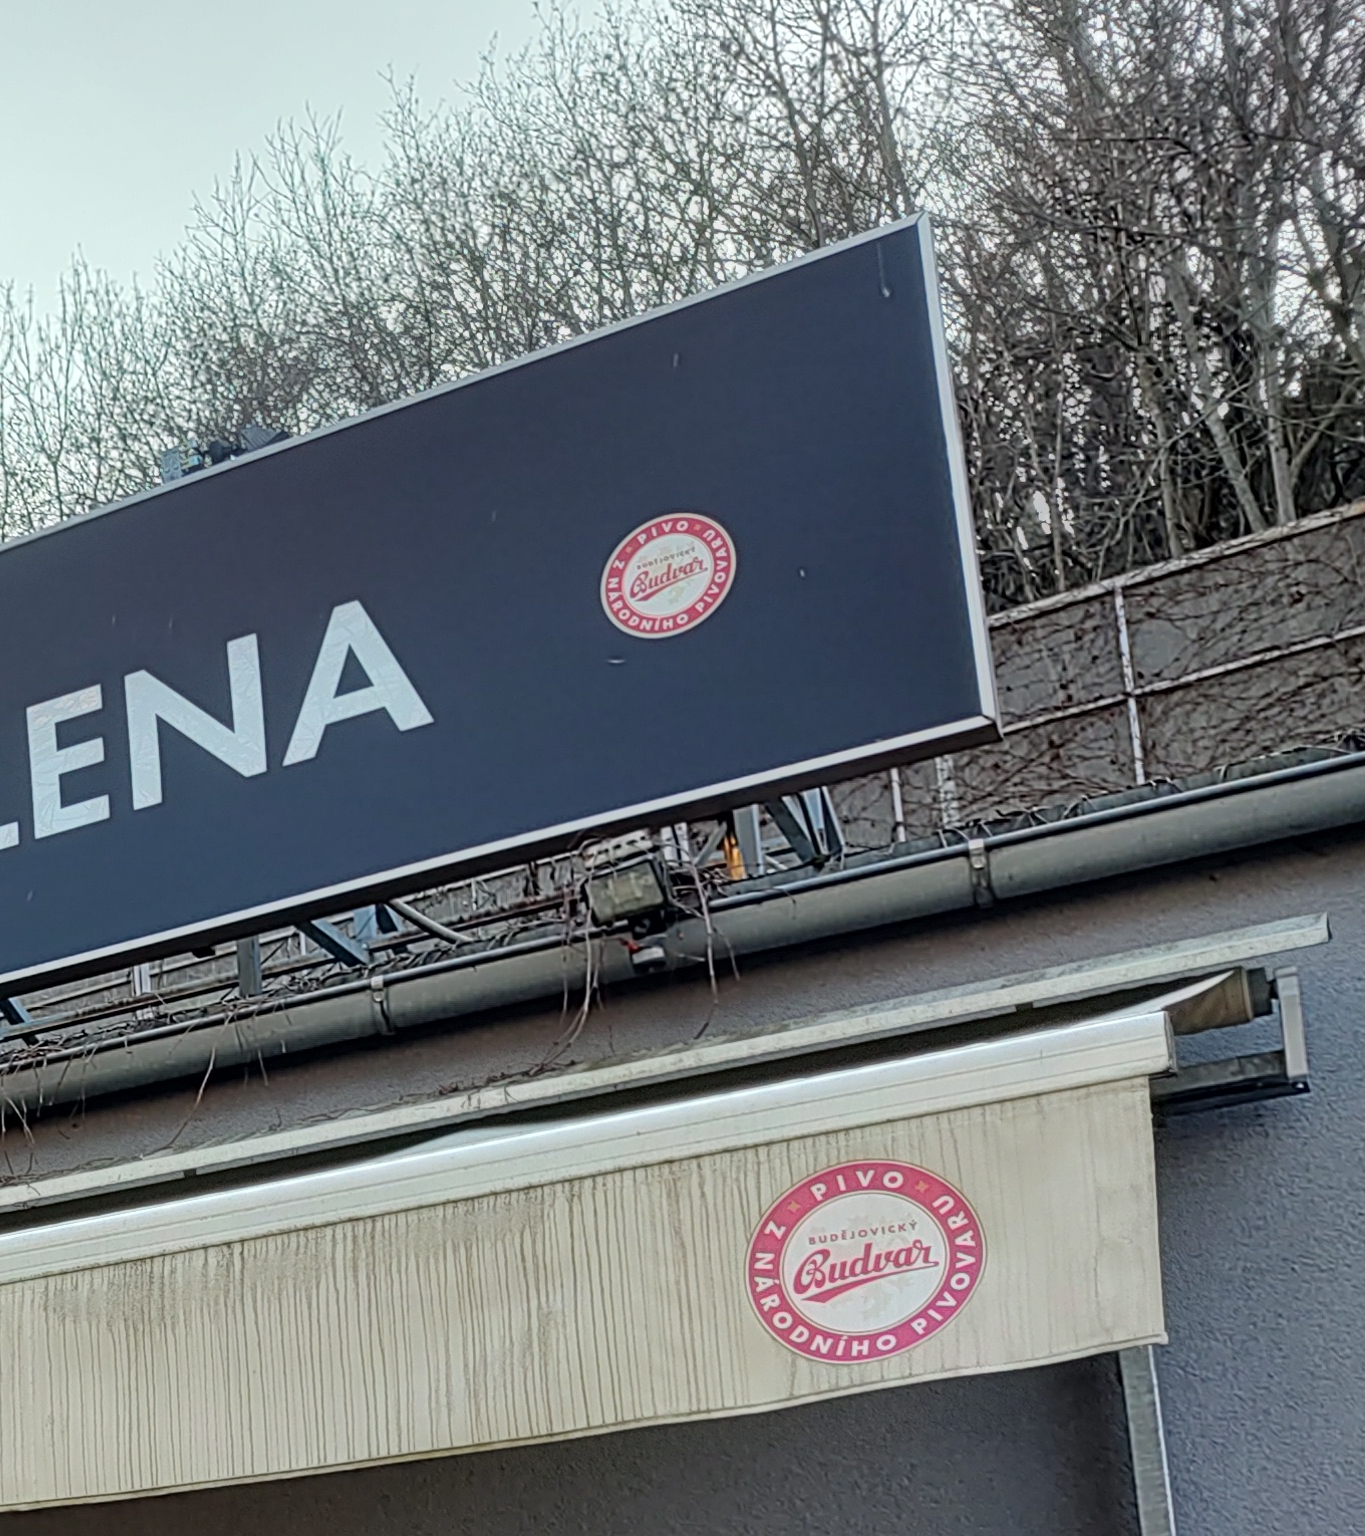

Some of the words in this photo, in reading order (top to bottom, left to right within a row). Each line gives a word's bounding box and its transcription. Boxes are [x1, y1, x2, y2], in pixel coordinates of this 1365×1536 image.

[636, 520, 689, 545] PIVO
[613, 559, 626, 570] Z
[630, 557, 708, 602] Budvar
[694, 528, 728, 613] PIVOVARU
[607, 577, 689, 631] NÁRODNÍHO
[810, 1169, 904, 1201] PIVO
[764, 1220, 786, 1239] Z
[808, 1219, 918, 1246] BUDĚJOVICKÝ
[792, 1239, 939, 1303] Budvar
[910, 1194, 977, 1335] PIVOVARU
[753, 1251, 897, 1357] NÁRODNÍHO
